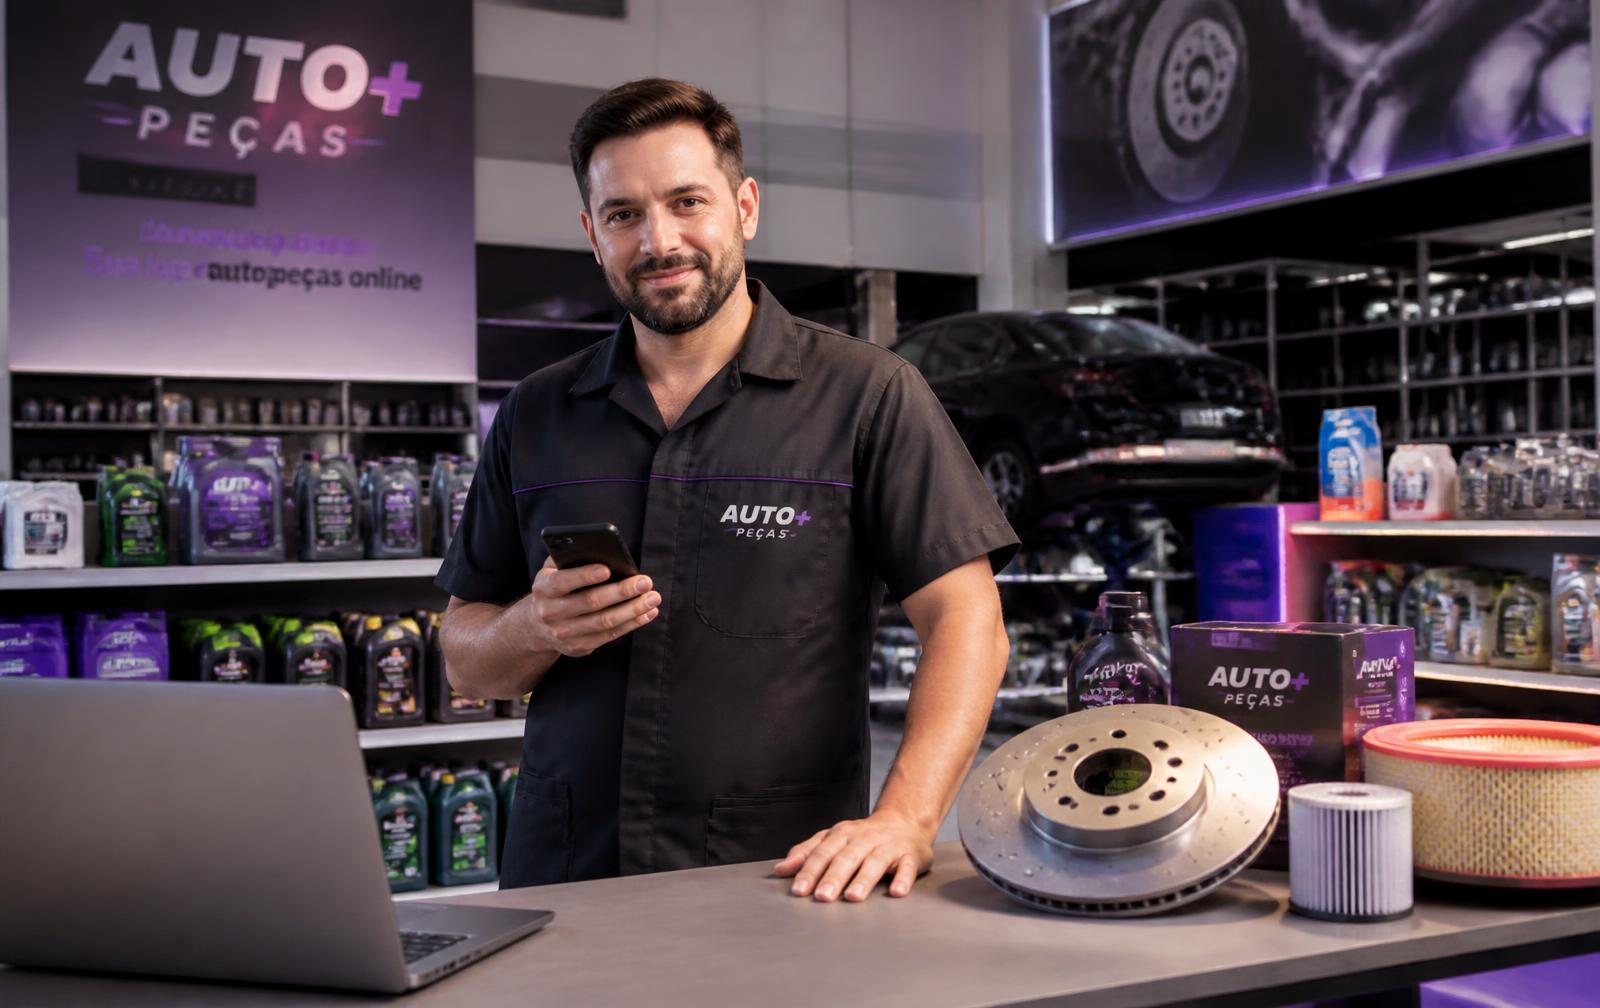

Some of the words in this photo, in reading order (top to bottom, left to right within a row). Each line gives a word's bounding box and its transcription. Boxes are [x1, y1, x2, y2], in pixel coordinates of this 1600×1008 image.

[137, 105, 348, 159] PEÇAS
[349, 265, 423, 291] online
[736, 527, 790, 541] PEÇAS
[1223, 692, 1285, 710] PEÇAS
